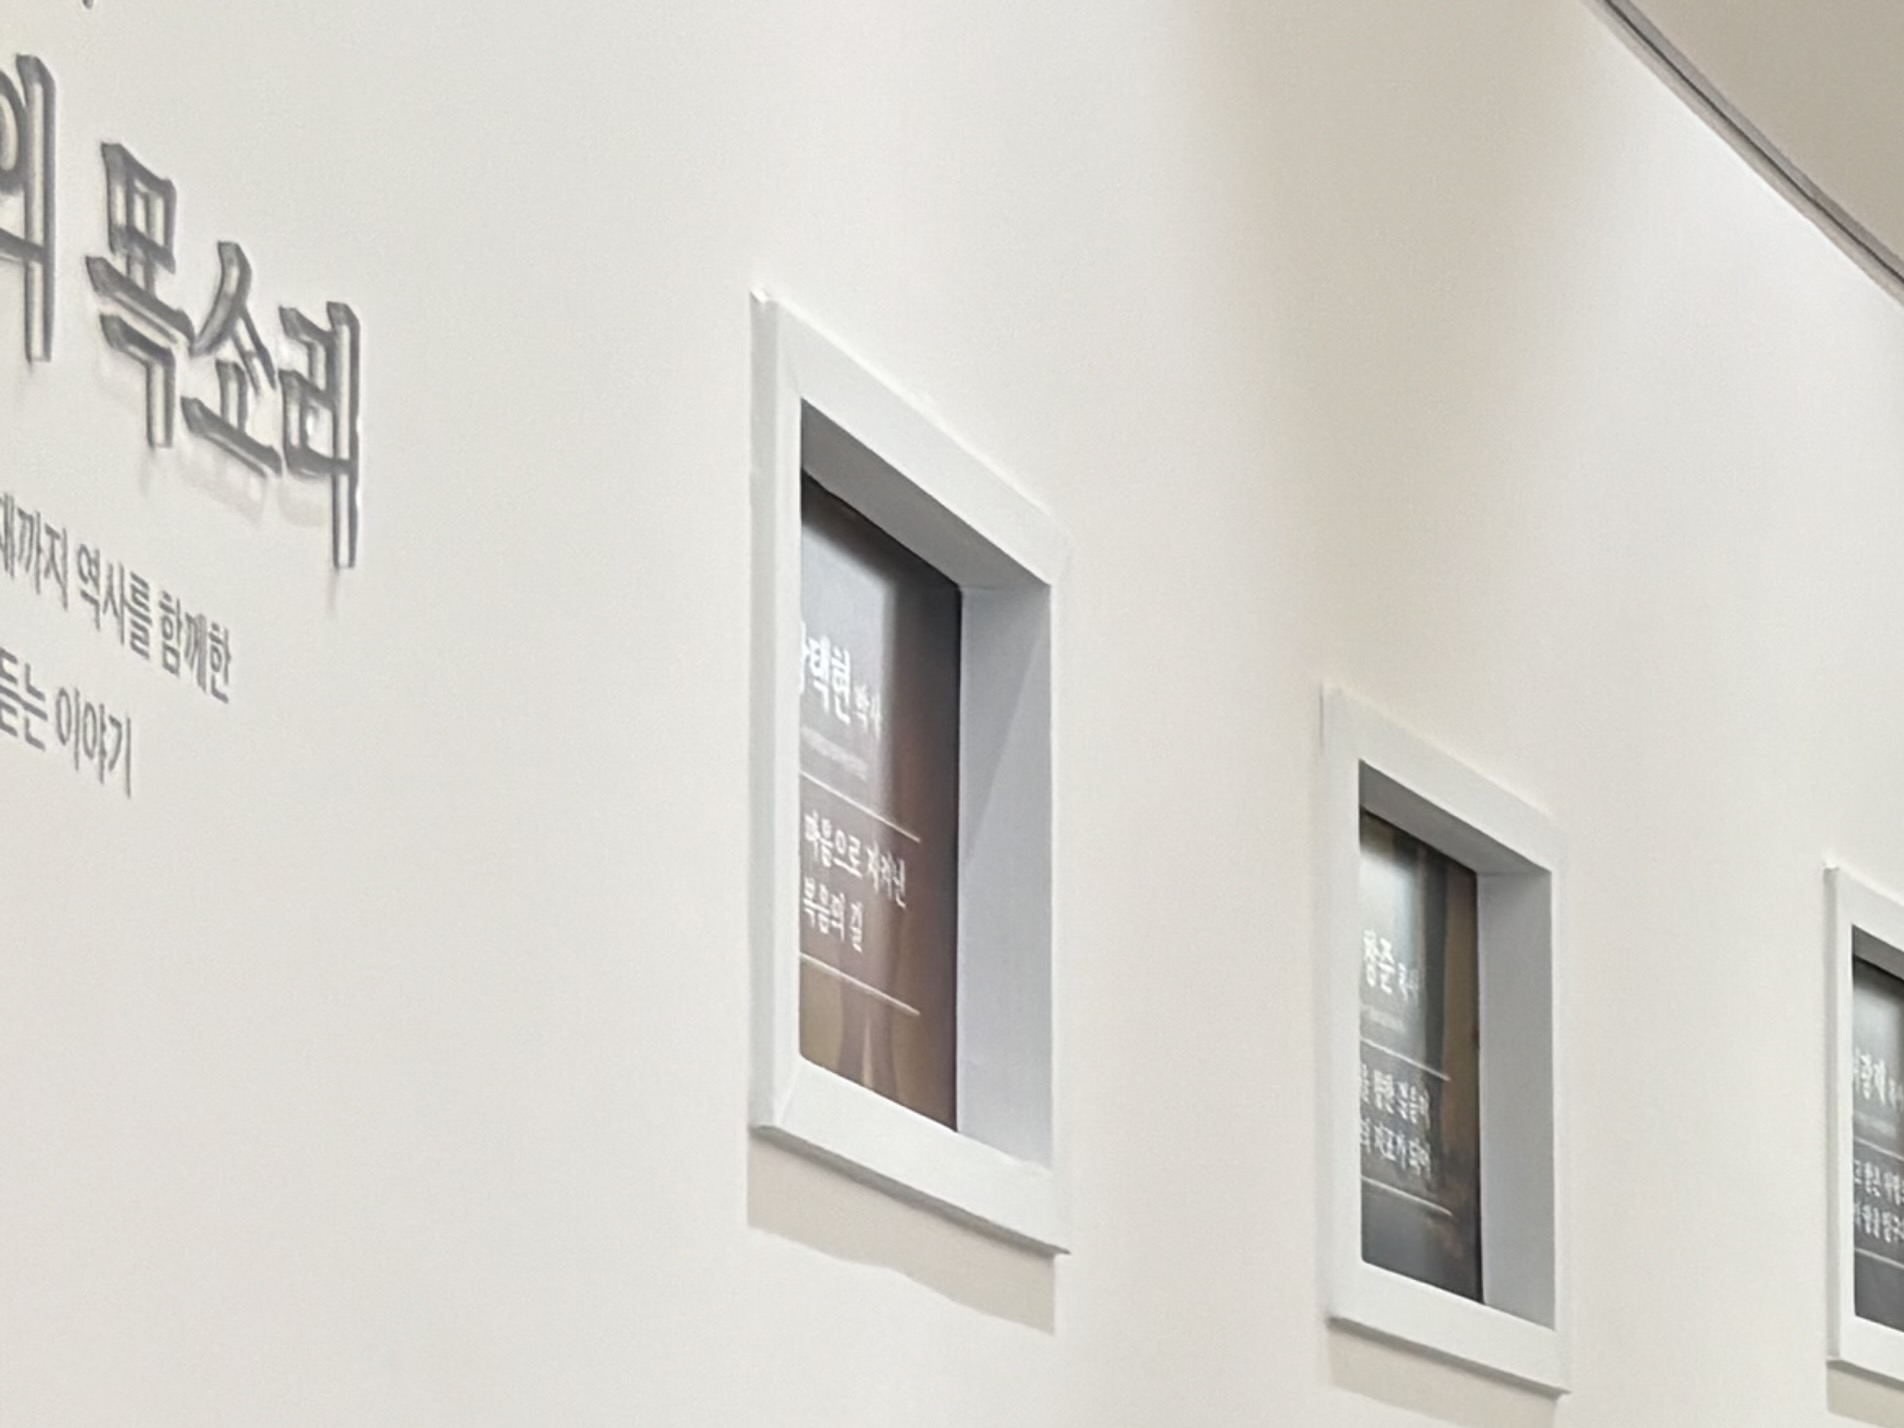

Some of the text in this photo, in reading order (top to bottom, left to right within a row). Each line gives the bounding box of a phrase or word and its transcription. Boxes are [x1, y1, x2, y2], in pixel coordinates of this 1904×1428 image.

[86, 141, 361, 570] 목소리
[76, 543, 154, 662] 역사를
[159, 590, 233, 705] 함께한
[55, 686, 133, 798] 이야기
